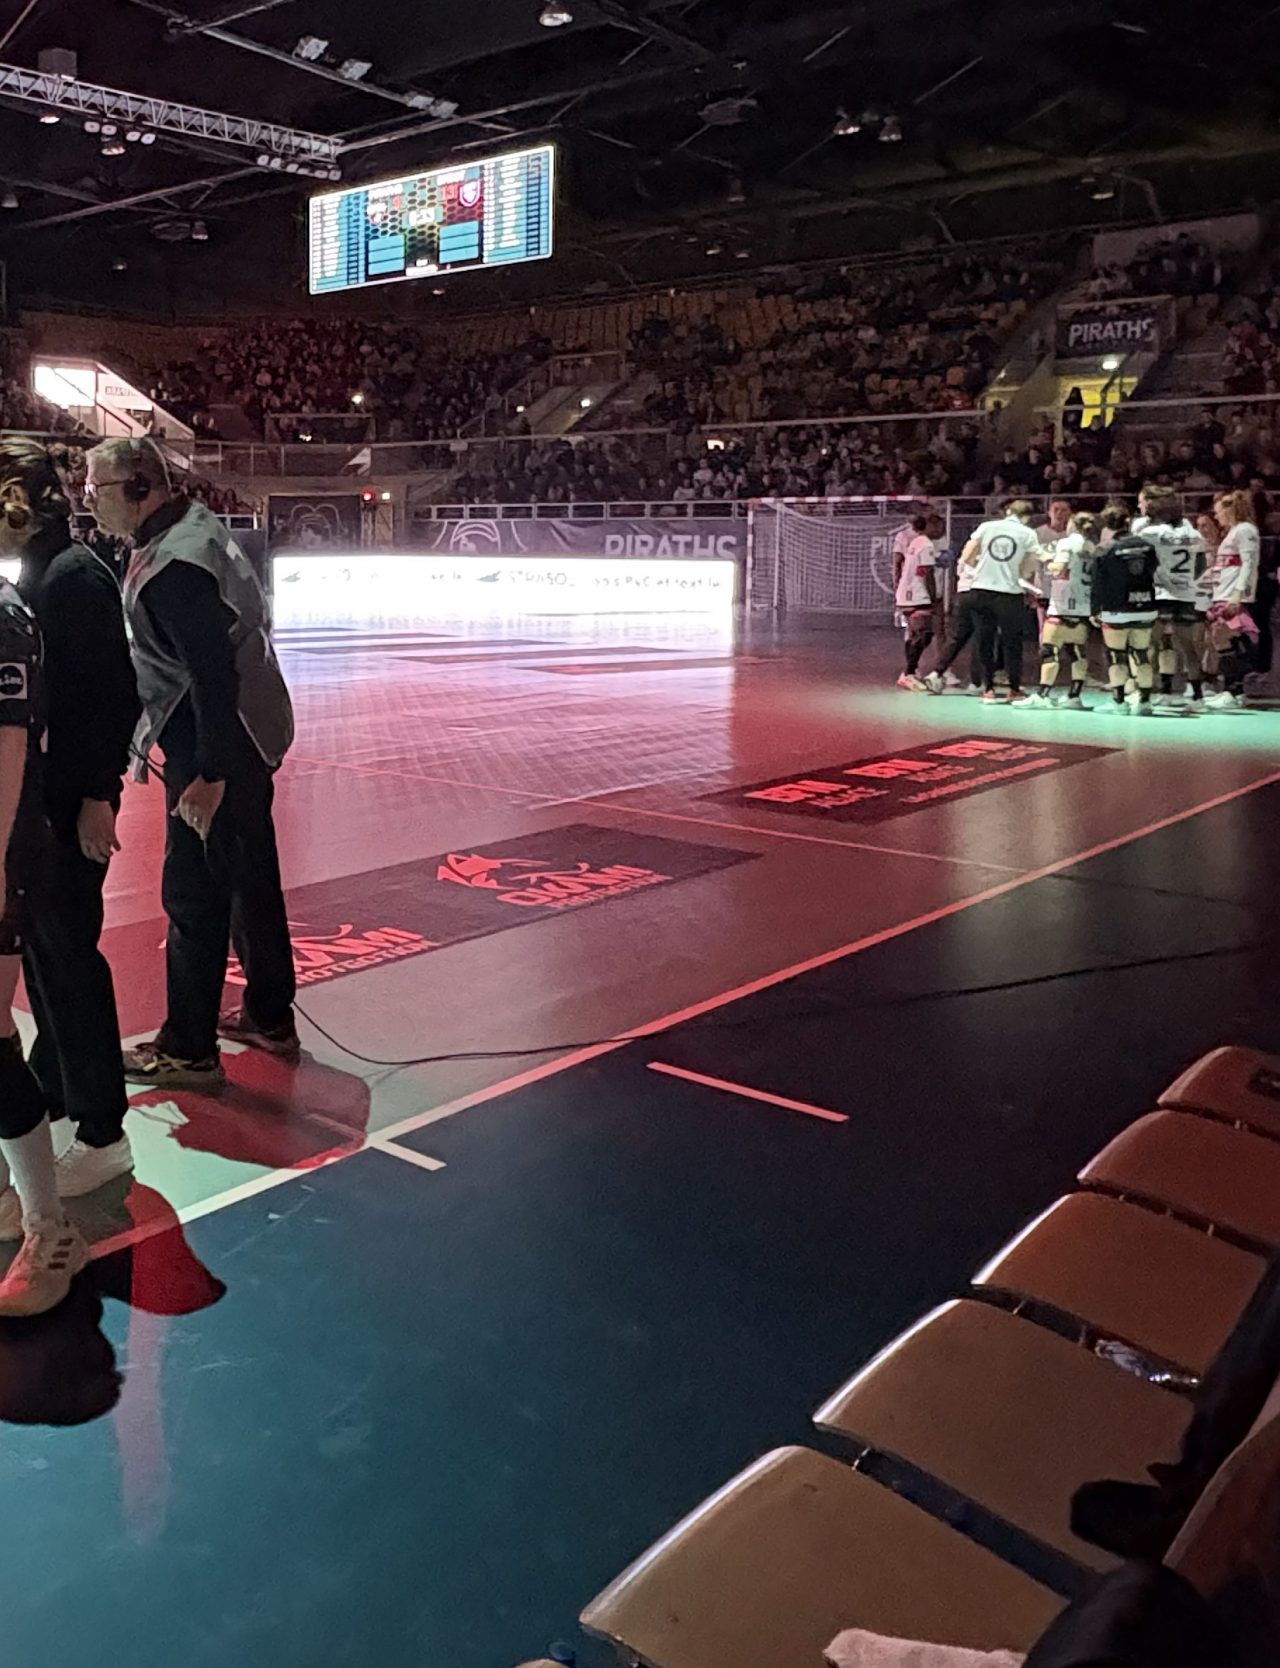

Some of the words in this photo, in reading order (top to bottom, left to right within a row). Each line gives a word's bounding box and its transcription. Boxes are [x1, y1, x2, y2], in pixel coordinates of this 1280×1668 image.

[1068, 318, 1156, 347] PIRATHS
[605, 534, 737, 558] PIRATHS
[1170, 549, 1192, 573] 2
[295, 938, 442, 985] ROTECTION
